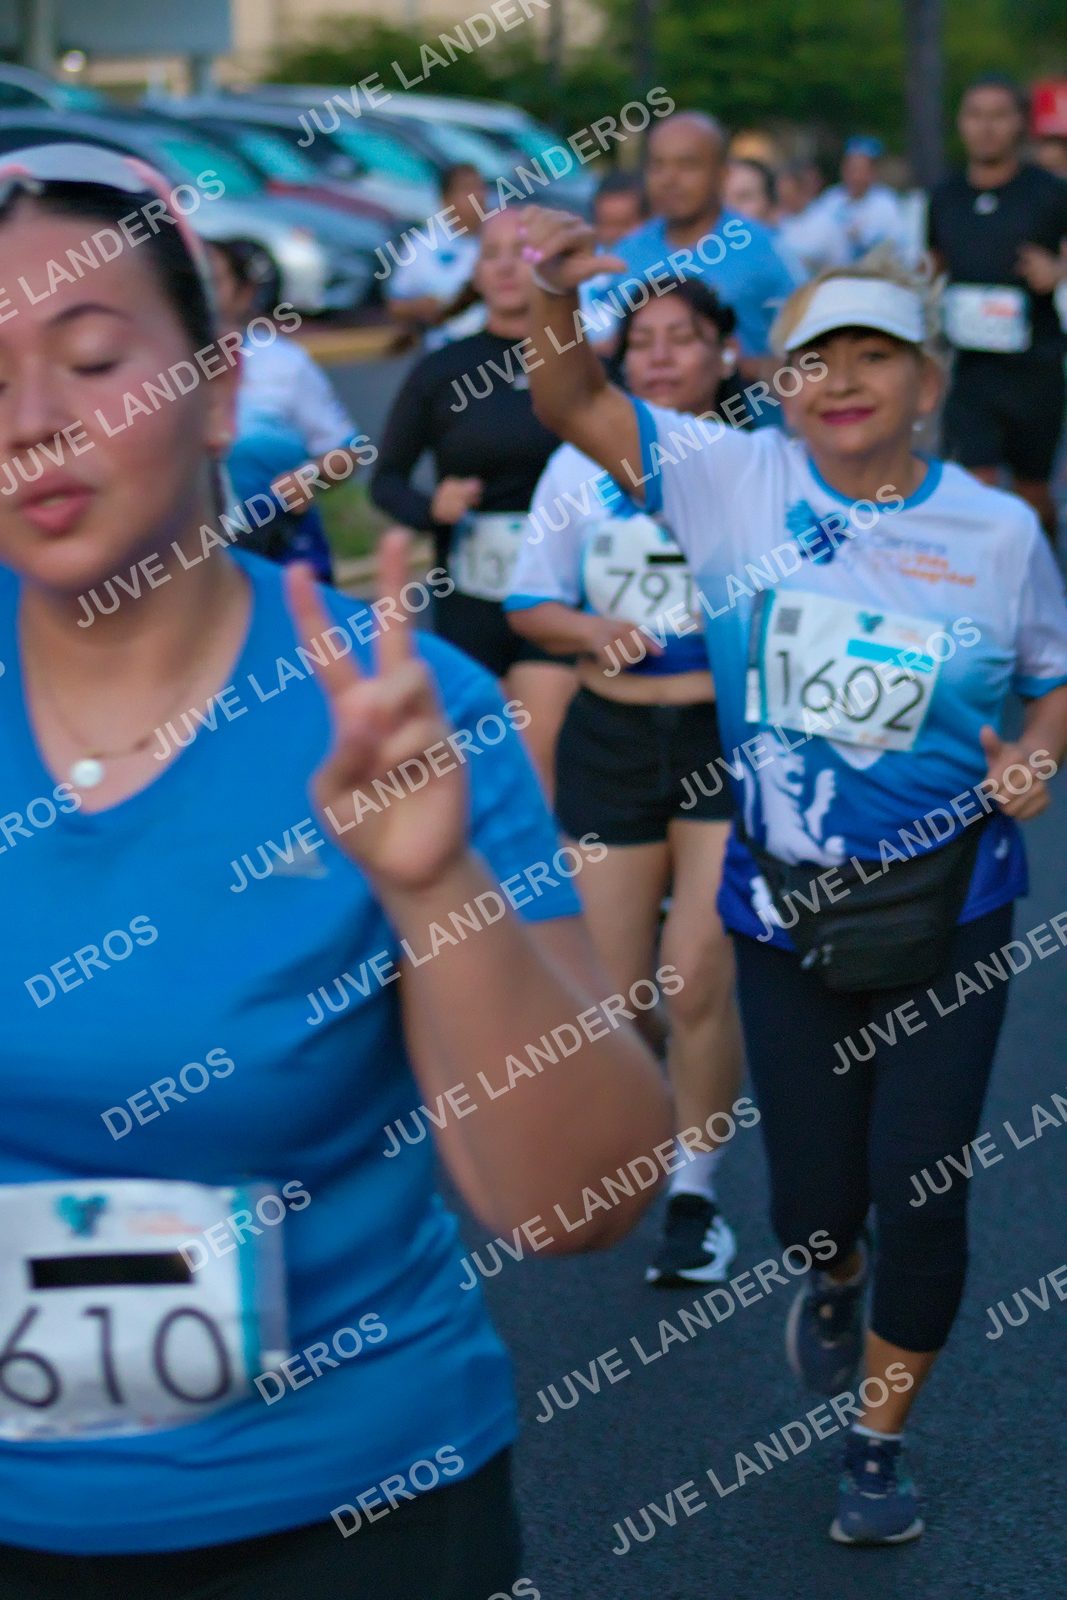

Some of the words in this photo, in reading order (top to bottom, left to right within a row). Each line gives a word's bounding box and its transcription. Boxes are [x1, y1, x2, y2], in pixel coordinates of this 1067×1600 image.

[606, 569, 693, 617] 791
[777, 650, 925, 732] 1602
[0, 1305, 233, 1410] 610
